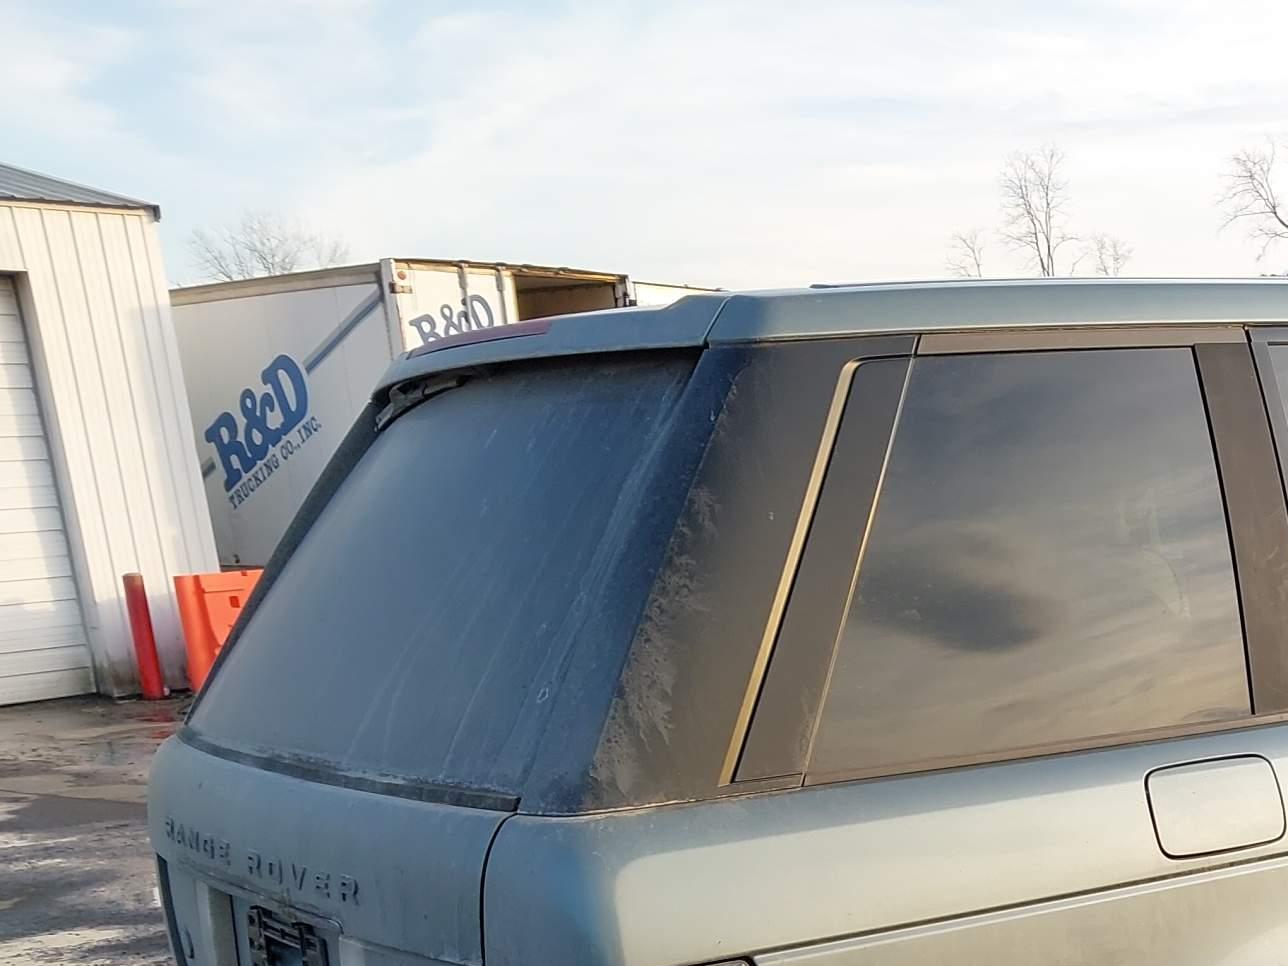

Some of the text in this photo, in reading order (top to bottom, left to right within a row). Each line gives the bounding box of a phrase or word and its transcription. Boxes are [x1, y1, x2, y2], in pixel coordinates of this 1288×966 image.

[408, 293, 495, 346] R&D
[204, 353, 309, 493] R&D
[228, 453, 281, 511] TRUCKING
[298, 416, 322, 444] INC.
[165, 817, 361, 906] RANGE ROVER
